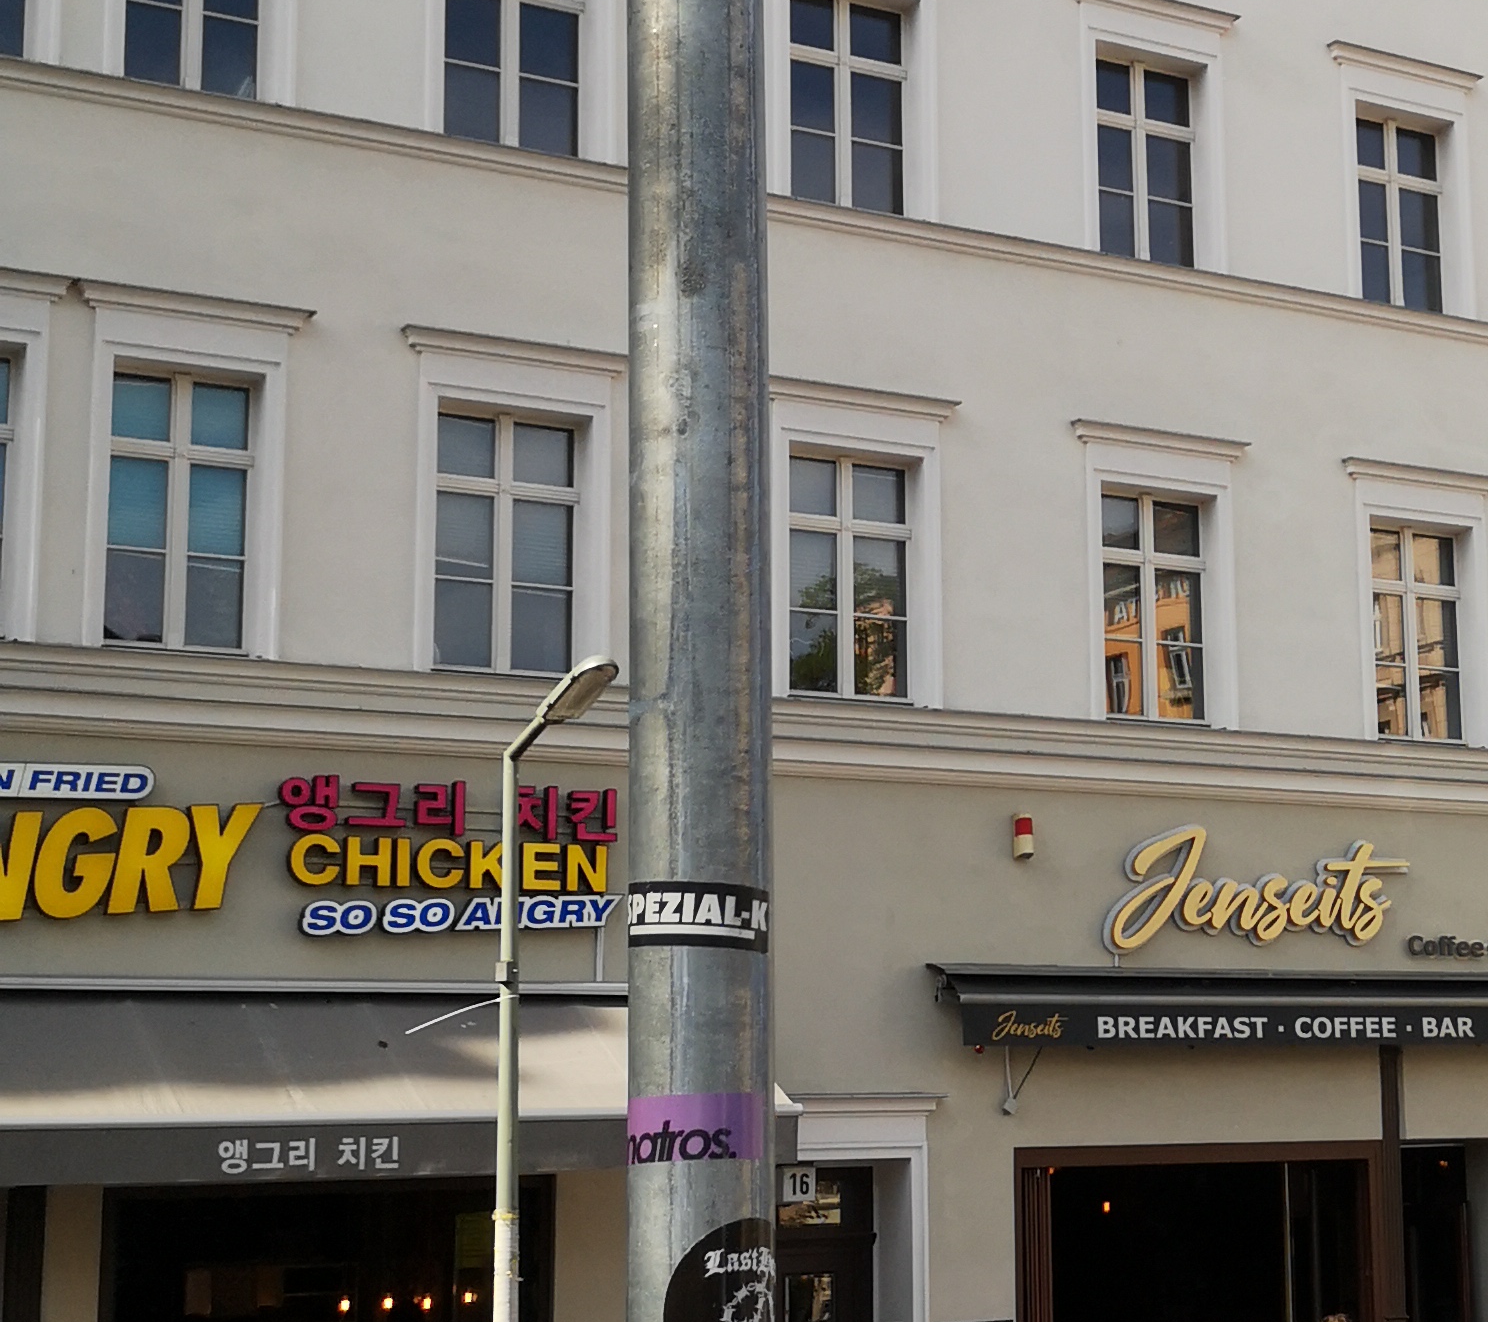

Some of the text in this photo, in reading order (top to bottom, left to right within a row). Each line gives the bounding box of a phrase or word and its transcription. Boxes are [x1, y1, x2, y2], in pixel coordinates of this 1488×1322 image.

[28, 770, 149, 794] FRIED
[278, 774, 467, 838] 앵그리
[290, 833, 609, 893] CHICKEN
[1108, 824, 1411, 953] Jenseits
[304, 901, 376, 934] SO
[384, 899, 454, 932] SO
[991, 1010, 1475, 1041] Jenseits BREAKFAST COFFEE BAR
[218, 1136, 399, 1174] 앵그리 치킨
[788, 1172, 810, 1196] 16
